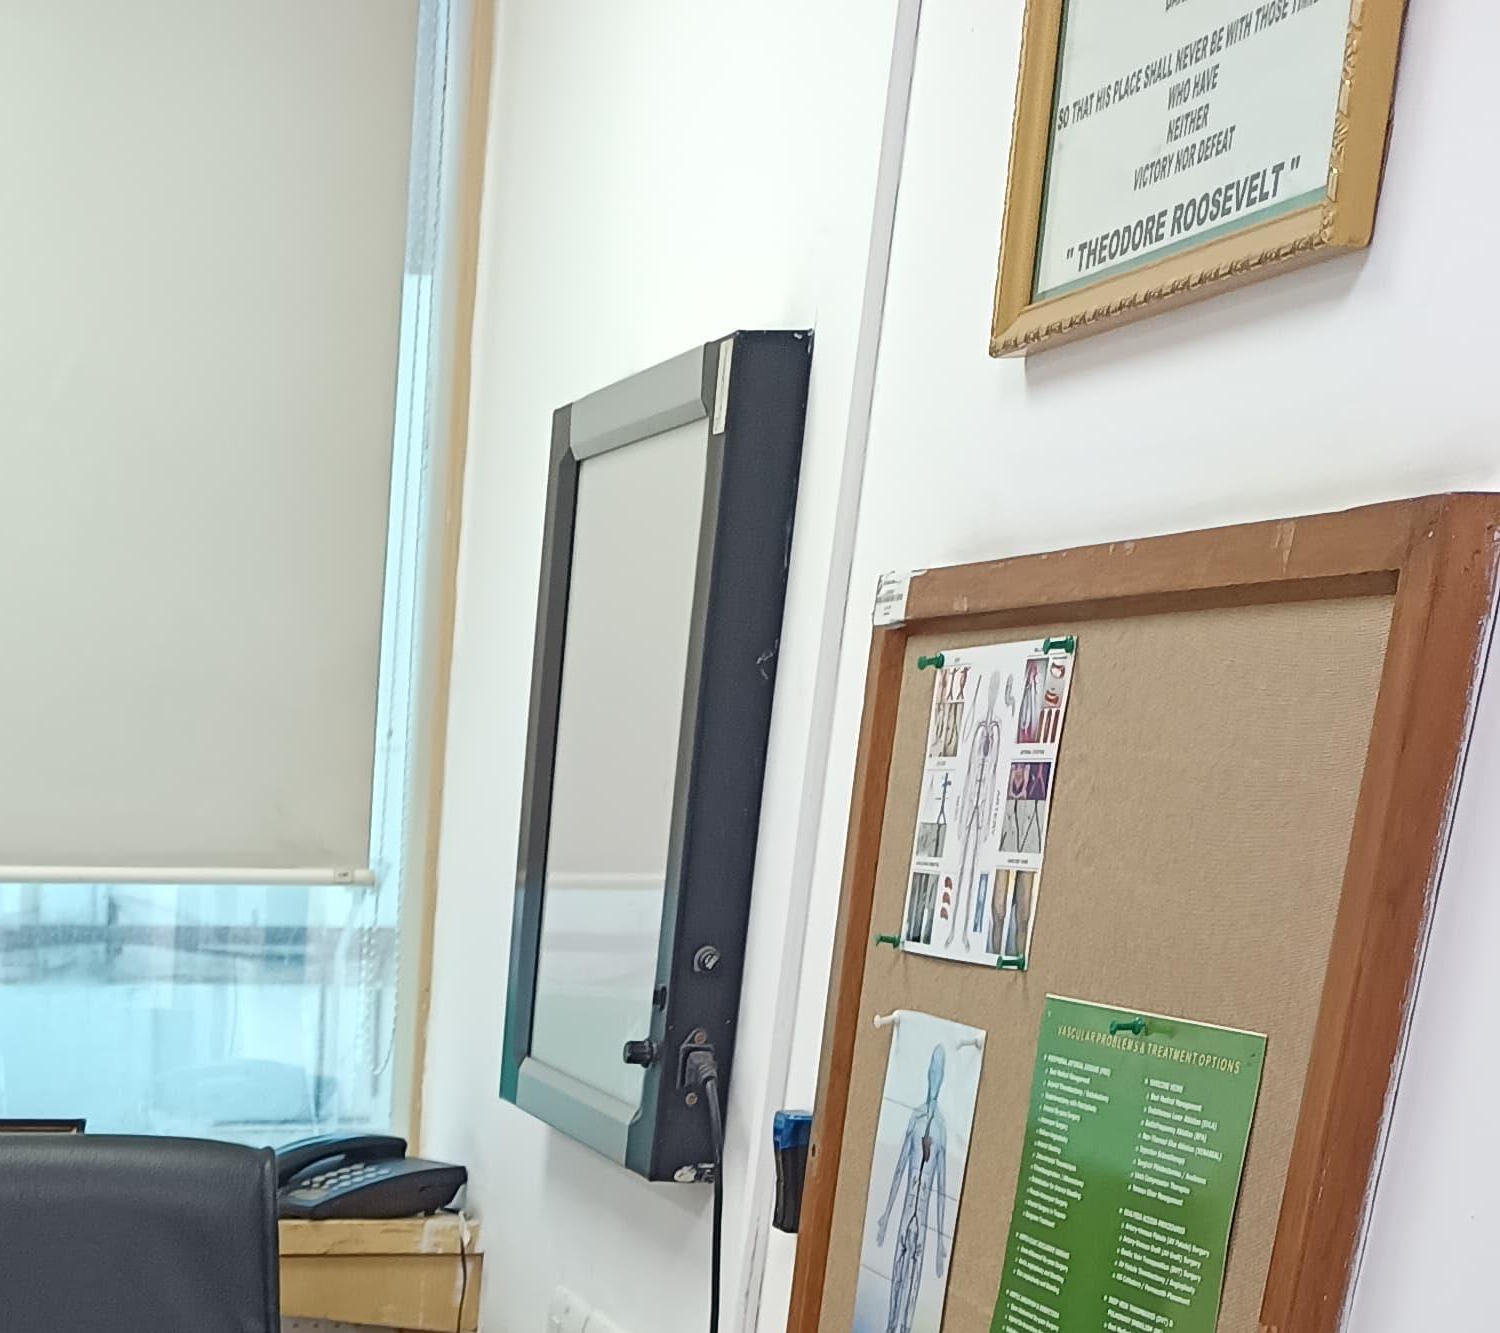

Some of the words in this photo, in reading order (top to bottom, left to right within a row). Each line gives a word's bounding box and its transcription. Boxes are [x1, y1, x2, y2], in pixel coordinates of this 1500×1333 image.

[1058, 105, 1070, 131] SO
[1072, 93, 1094, 124] THAT
[1095, 85, 1111, 112] HIS
[1112, 66, 1142, 105] PLACE
[1143, 53, 1172, 88] SHALL
[1175, 35, 1208, 73] NEVER
[1210, 27, 1225, 56] BE
[1226, 11, 1252, 48] WITH
[1254, 1, 1289, 34] THOSE
[1167, 81, 1191, 110] WHO
[1192, 63, 1220, 97] HAVE
[1166, 104, 1209, 144] NEITHER
[1133, 152, 1175, 191] VICTORY
[1174, 142, 1197, 176] NOR
[1197, 125, 1236, 165] DEFEAT
[1077, 209, 1168, 272] THEODORE
[1170, 162, 1285, 237] ROOSEVELT
[1058, 1024, 1097, 1044] VASCULAR
[1096, 1032, 1140, 1053] PROBLEMS
[1147, 1042, 1199, 1065] TREATMENT
[1198, 1054, 1241, 1074] OPTIONS
